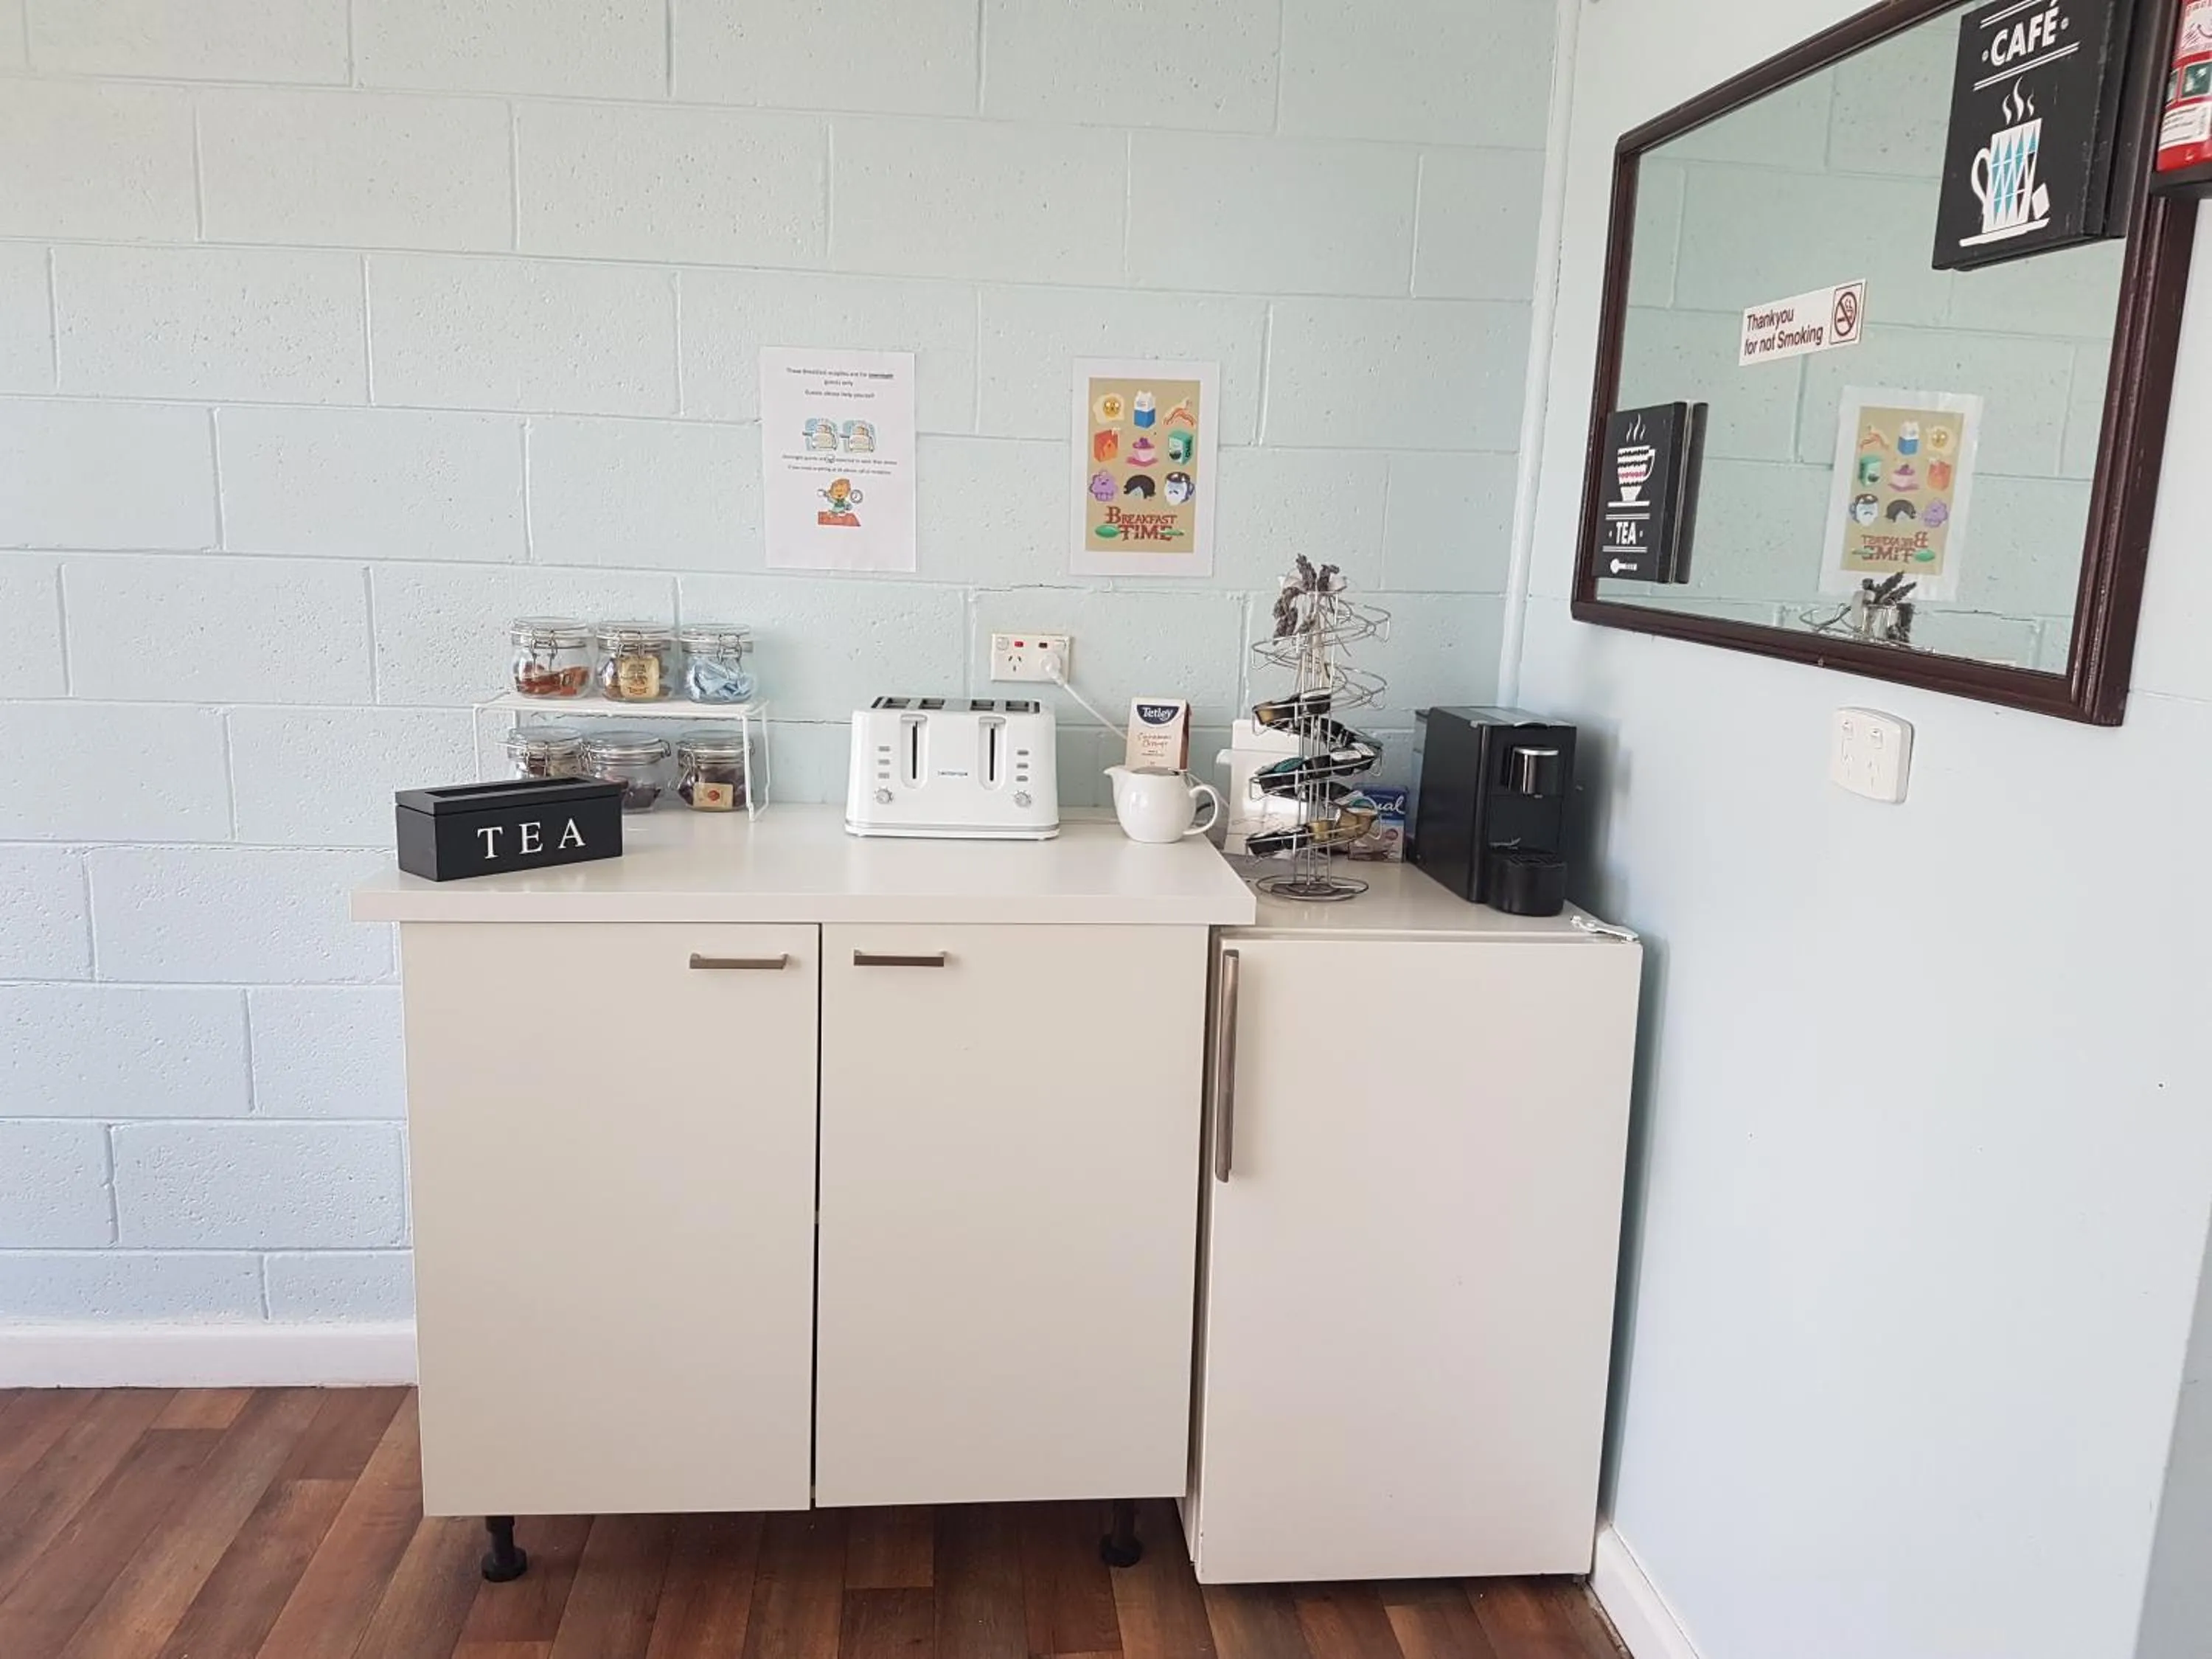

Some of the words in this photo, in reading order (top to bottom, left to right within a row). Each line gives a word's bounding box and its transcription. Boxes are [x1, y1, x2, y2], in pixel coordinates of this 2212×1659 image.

[1991, 0, 2059, 66] CAFÉ
[1747, 308, 1794, 332] Thankyou
[1745, 338, 1757, 355] for
[1759, 335, 1775, 353] not
[1777, 325, 1823, 349] Smoking
[1104, 506, 1178, 524] BREAKFAST
[1119, 524, 1172, 541] TIME
[1615, 521, 1637, 545] TEA
[1142, 707, 1174, 722] Tetley
[477, 818, 586, 860] TEA
